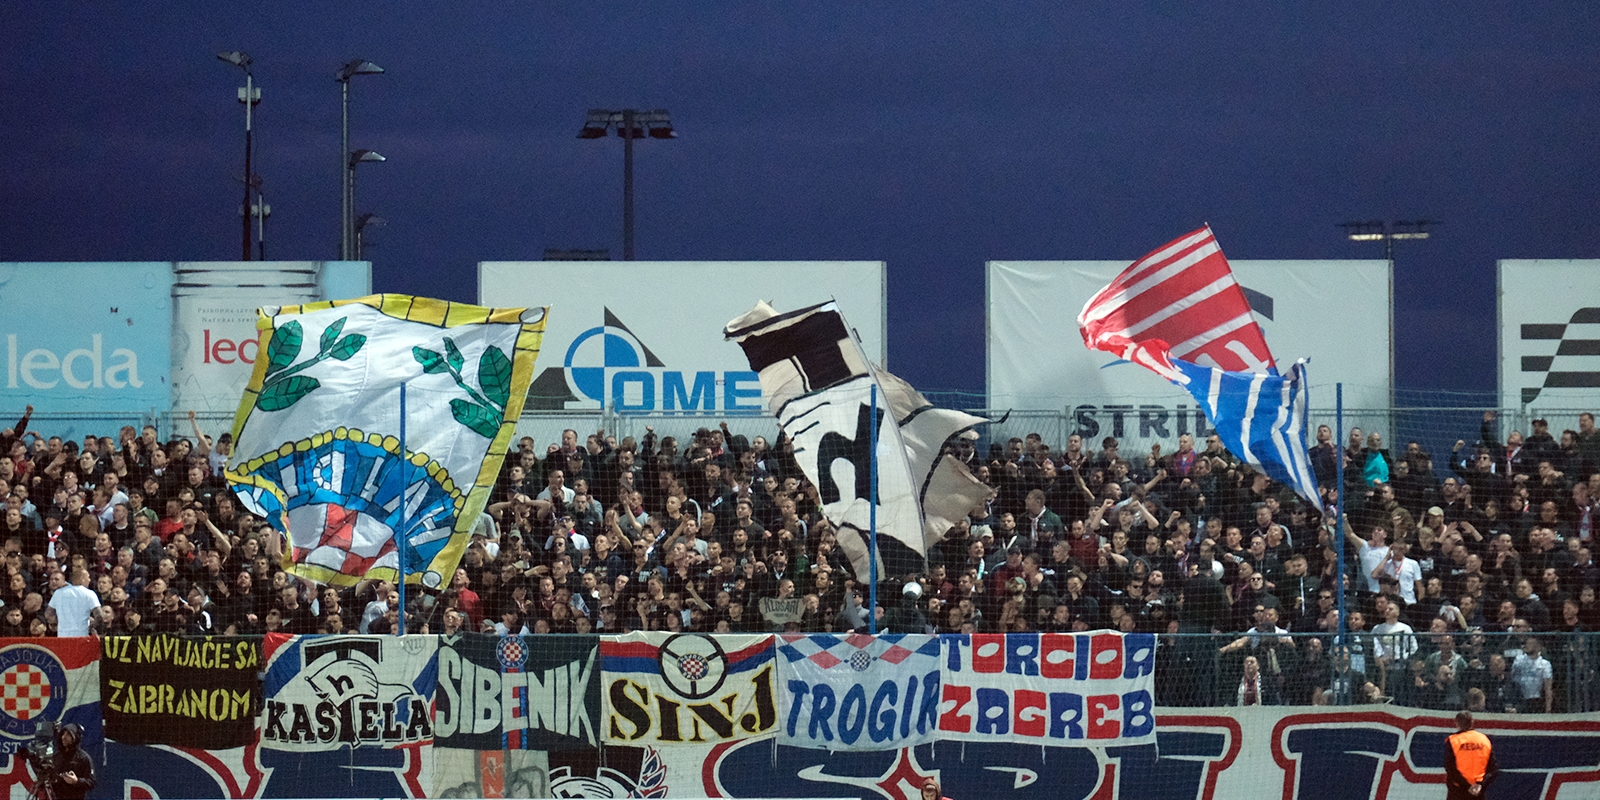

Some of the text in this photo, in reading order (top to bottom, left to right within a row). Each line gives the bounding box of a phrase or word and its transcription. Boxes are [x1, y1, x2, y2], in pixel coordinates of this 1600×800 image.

[7, 333, 144, 389] leda
[0, 649, 58, 673] AJDUK
[104, 633, 258, 670] UZ NAVIJAČE SA
[940, 632, 1156, 681] TORCIDA
[107, 679, 251, 722] ZABRANOM
[609, 665, 777, 742] SINJ
[786, 670, 940, 745] TROGIR
[939, 683, 1154, 740] ZAGREB
